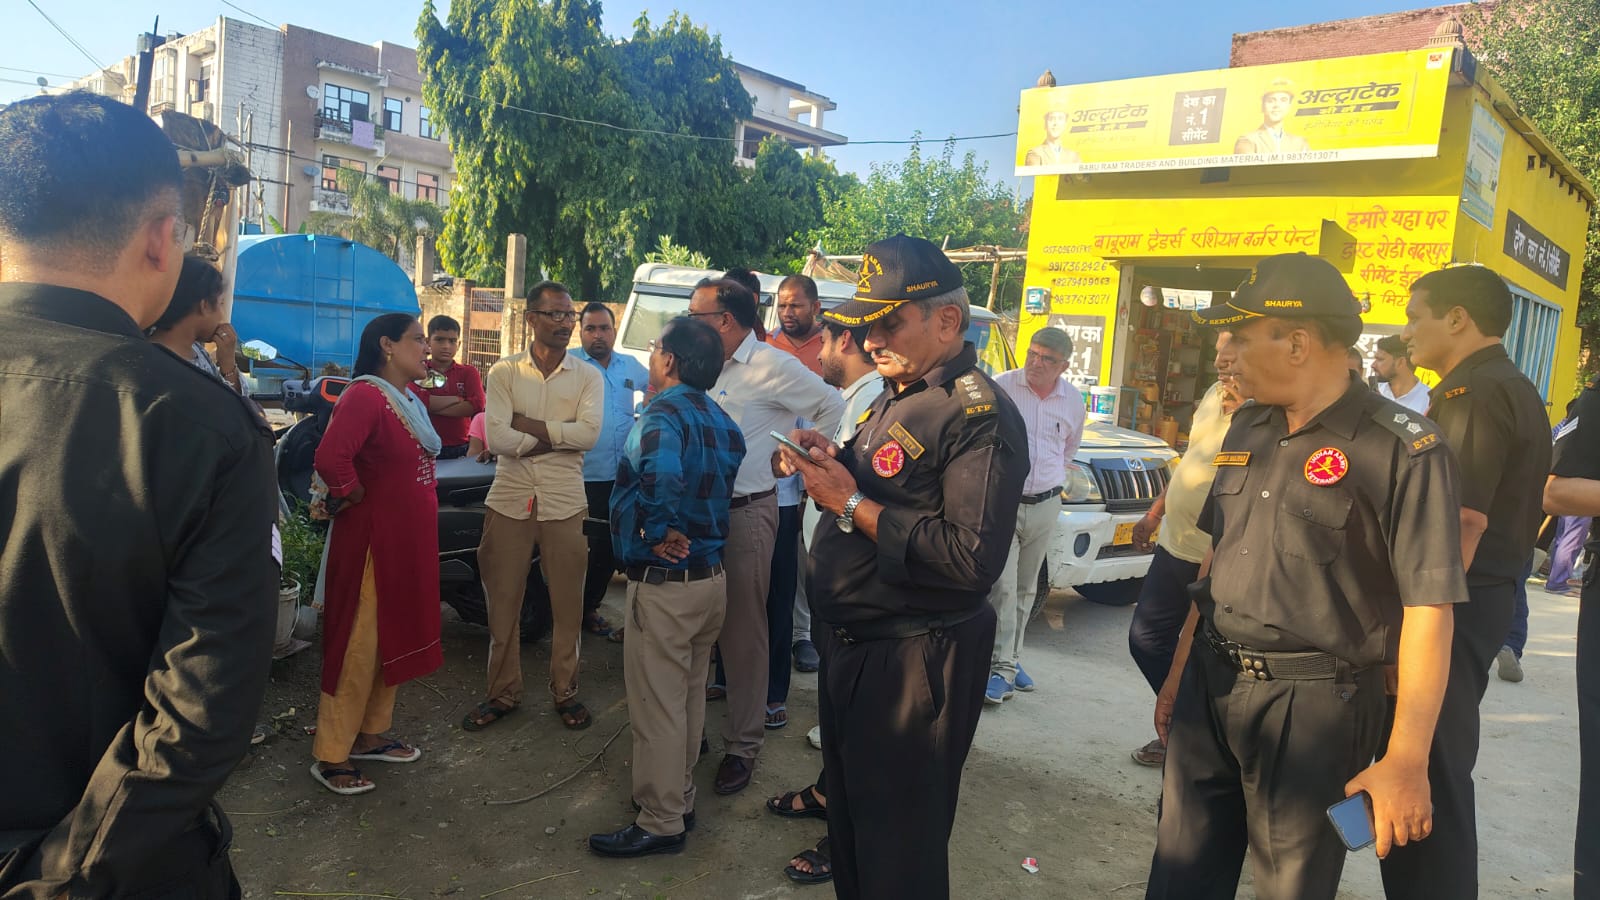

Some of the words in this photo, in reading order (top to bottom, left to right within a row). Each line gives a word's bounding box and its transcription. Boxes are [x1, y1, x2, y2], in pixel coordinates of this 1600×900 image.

[1183, 95, 1200, 108] देश
[1202, 95, 1216, 106] का
[1199, 109, 1208, 125] 1
[1078, 164, 1100, 172] BABU
[1101, 163, 1118, 171] RAM
[1120, 160, 1157, 170] TRADERS
[1159, 159, 1176, 168] AND
[1178, 157, 1219, 167] BUILDING
[1220, 153, 1265, 164] MATERIAL
[1346, 205, 1389, 232] हमारे
[1426, 210, 1450, 230] पर
[1094, 234, 1143, 254] बाबूराम
[1147, 227, 1187, 252] ट्रेडर्स
[1191, 226, 1244, 248] एशियन
[1243, 224, 1281, 247] बर्जर
[1283, 225, 1319, 247] पेन्ट
[1527, 238, 1539, 263] का
[1049, 261, 1107, 272] 9917362426
[906, 280, 939, 293] SHAURYA
[1264, 300, 1302, 308] SHAURYA
[862, 304, 894, 322] SERVED
[1209, 314, 1244, 324] SERVED
[1081, 326, 1102, 343] का
[965, 404, 992, 414] ETF
[1412, 433, 1437, 450] ETF
[1310, 449, 1334, 464] INDIAN
[1333, 451, 1346, 469] ARMY
[1308, 470, 1339, 484] VETERANS
